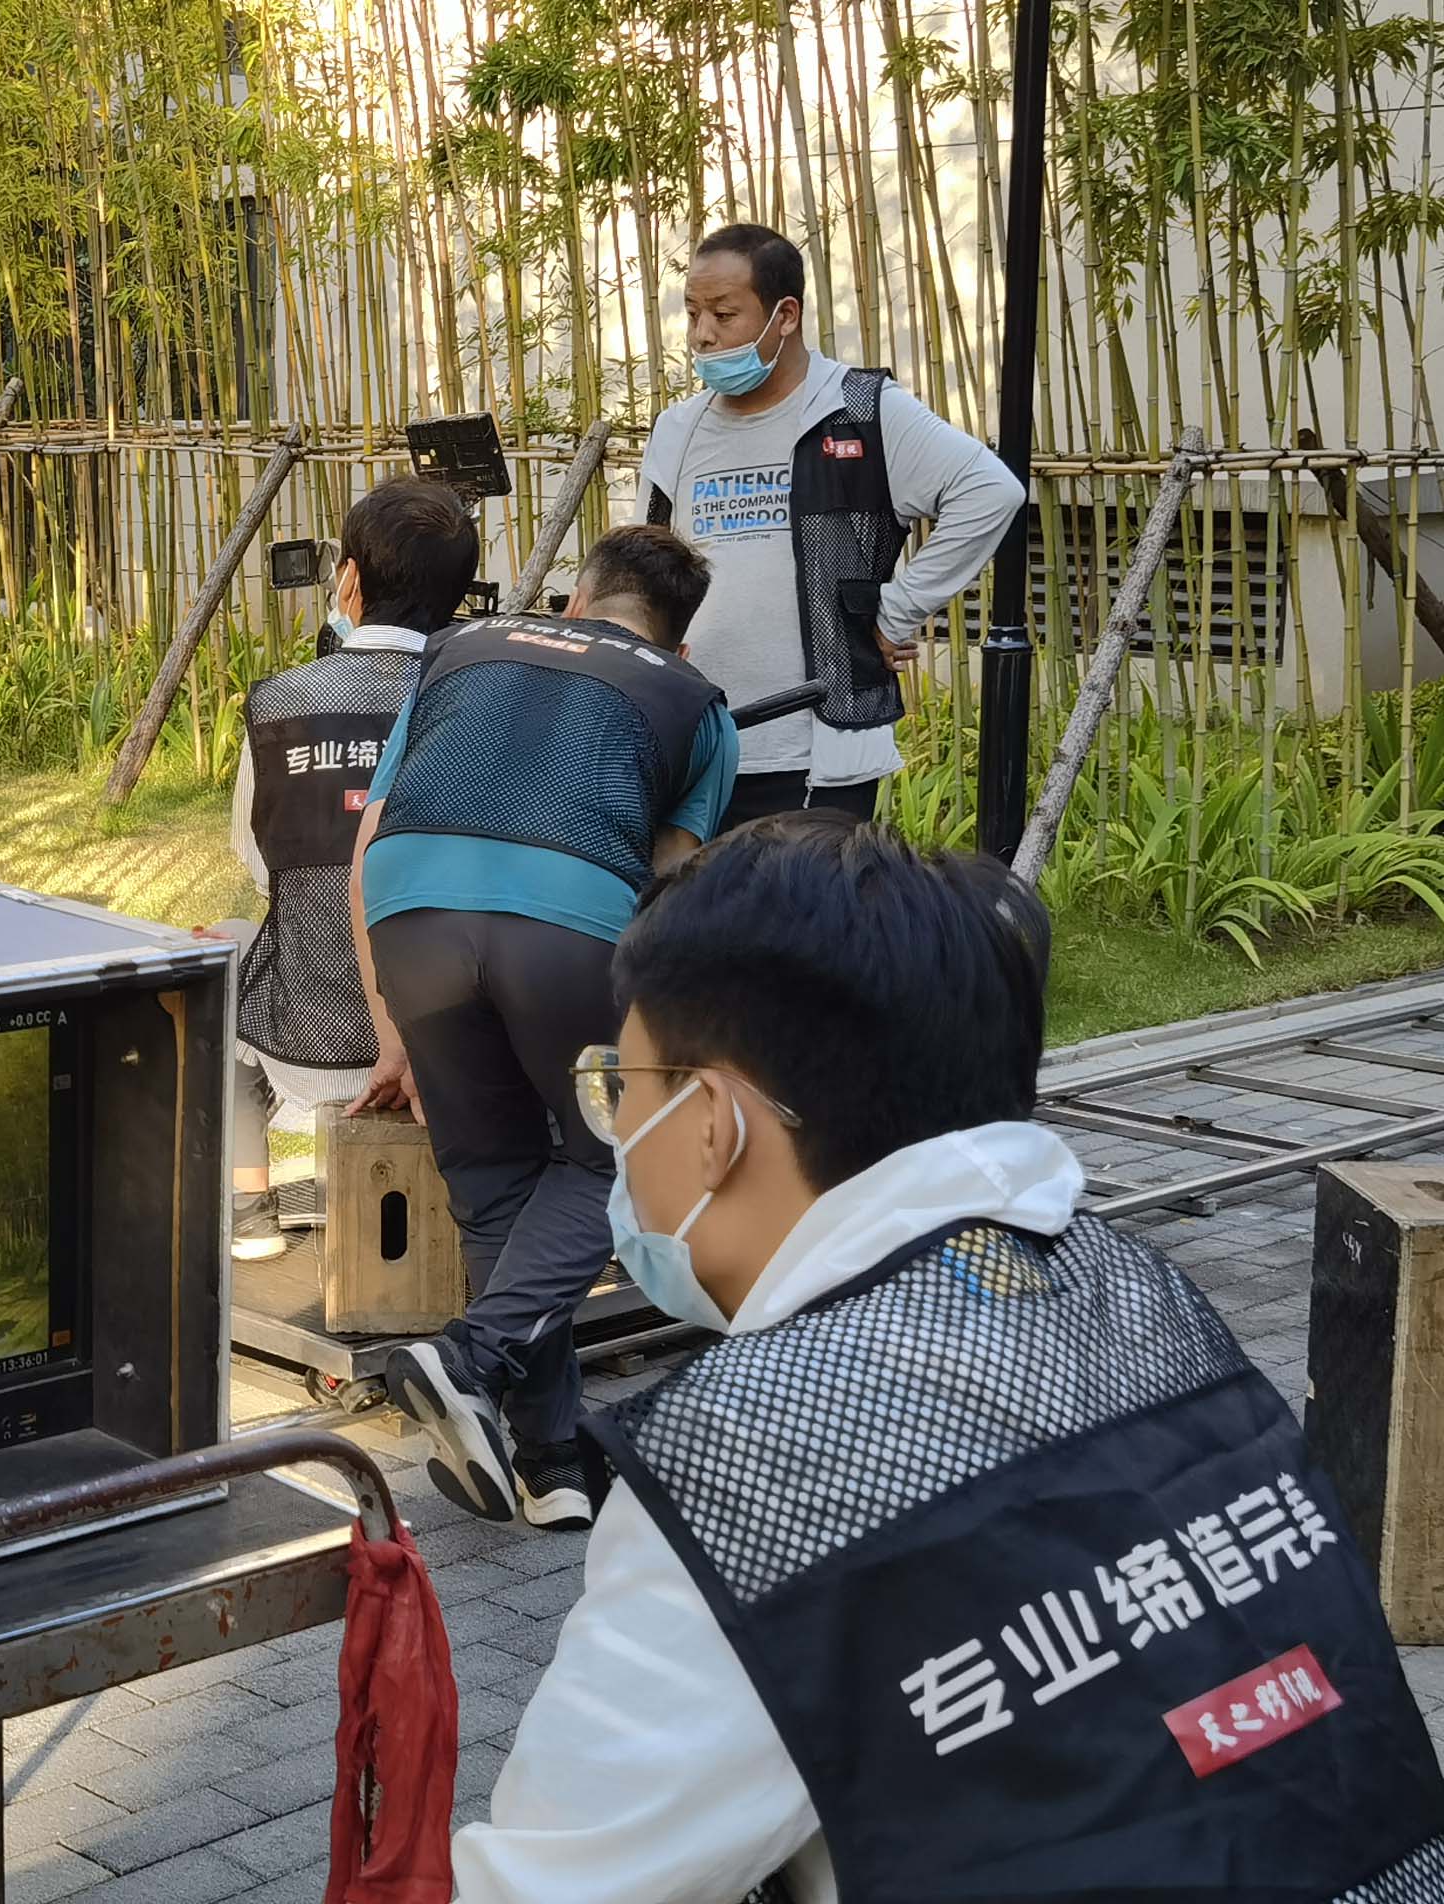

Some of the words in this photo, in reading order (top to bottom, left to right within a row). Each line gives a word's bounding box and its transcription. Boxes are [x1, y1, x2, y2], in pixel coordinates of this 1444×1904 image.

[692, 504, 701, 516] IS
[703, 501, 726, 513] THE
[692, 516, 716, 535] OF
[285, 739, 389, 775] 专业缔
[57, 1010, 68, 1026] A
